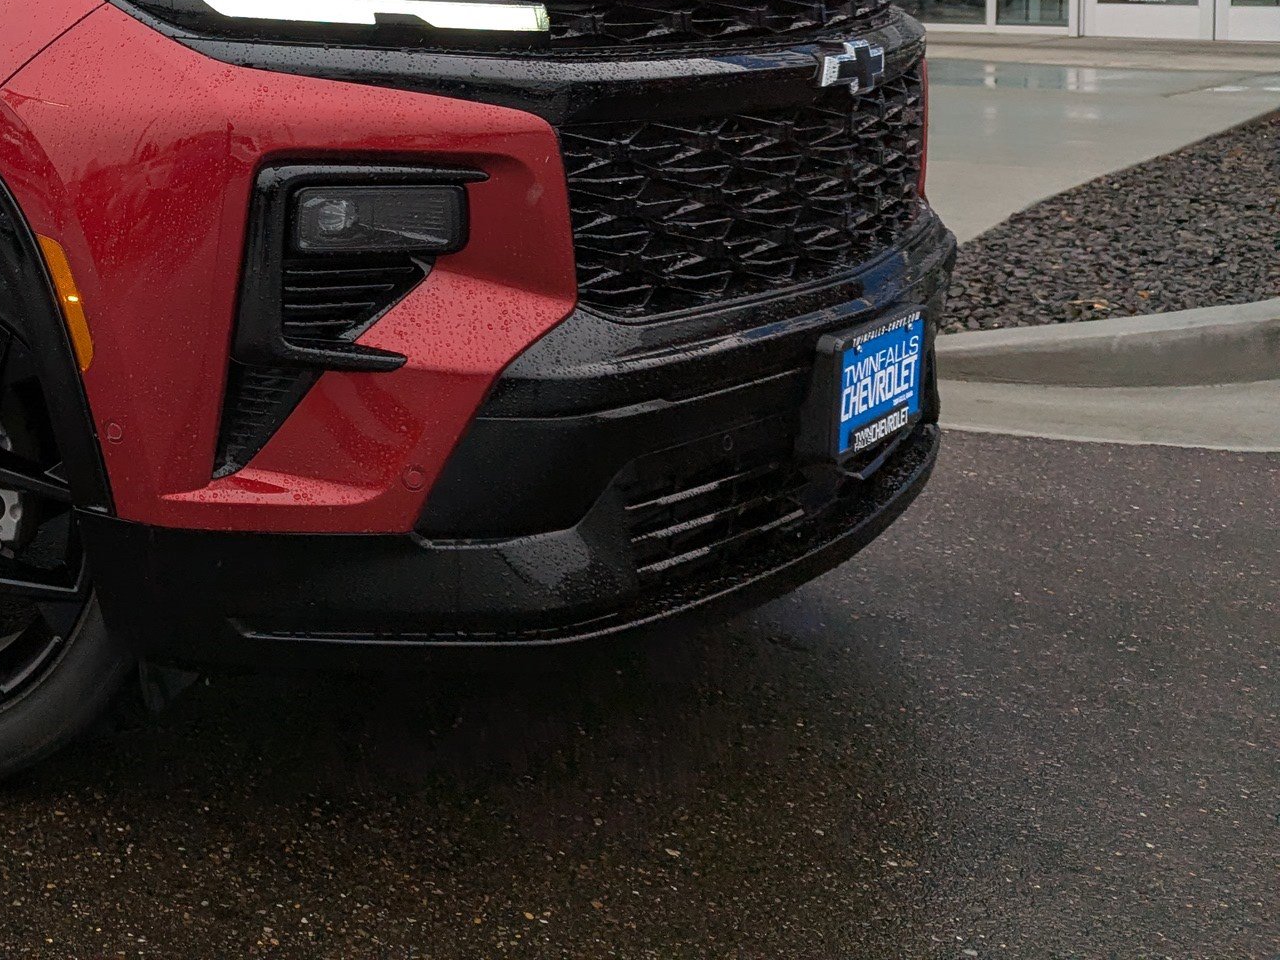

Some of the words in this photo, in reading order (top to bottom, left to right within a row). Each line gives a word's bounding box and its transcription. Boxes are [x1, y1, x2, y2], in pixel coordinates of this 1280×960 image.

[844, 335, 920, 387] TWINFALLS
[841, 354, 919, 423] CHEVROLET
[871, 406, 910, 443] CHEVROLET
